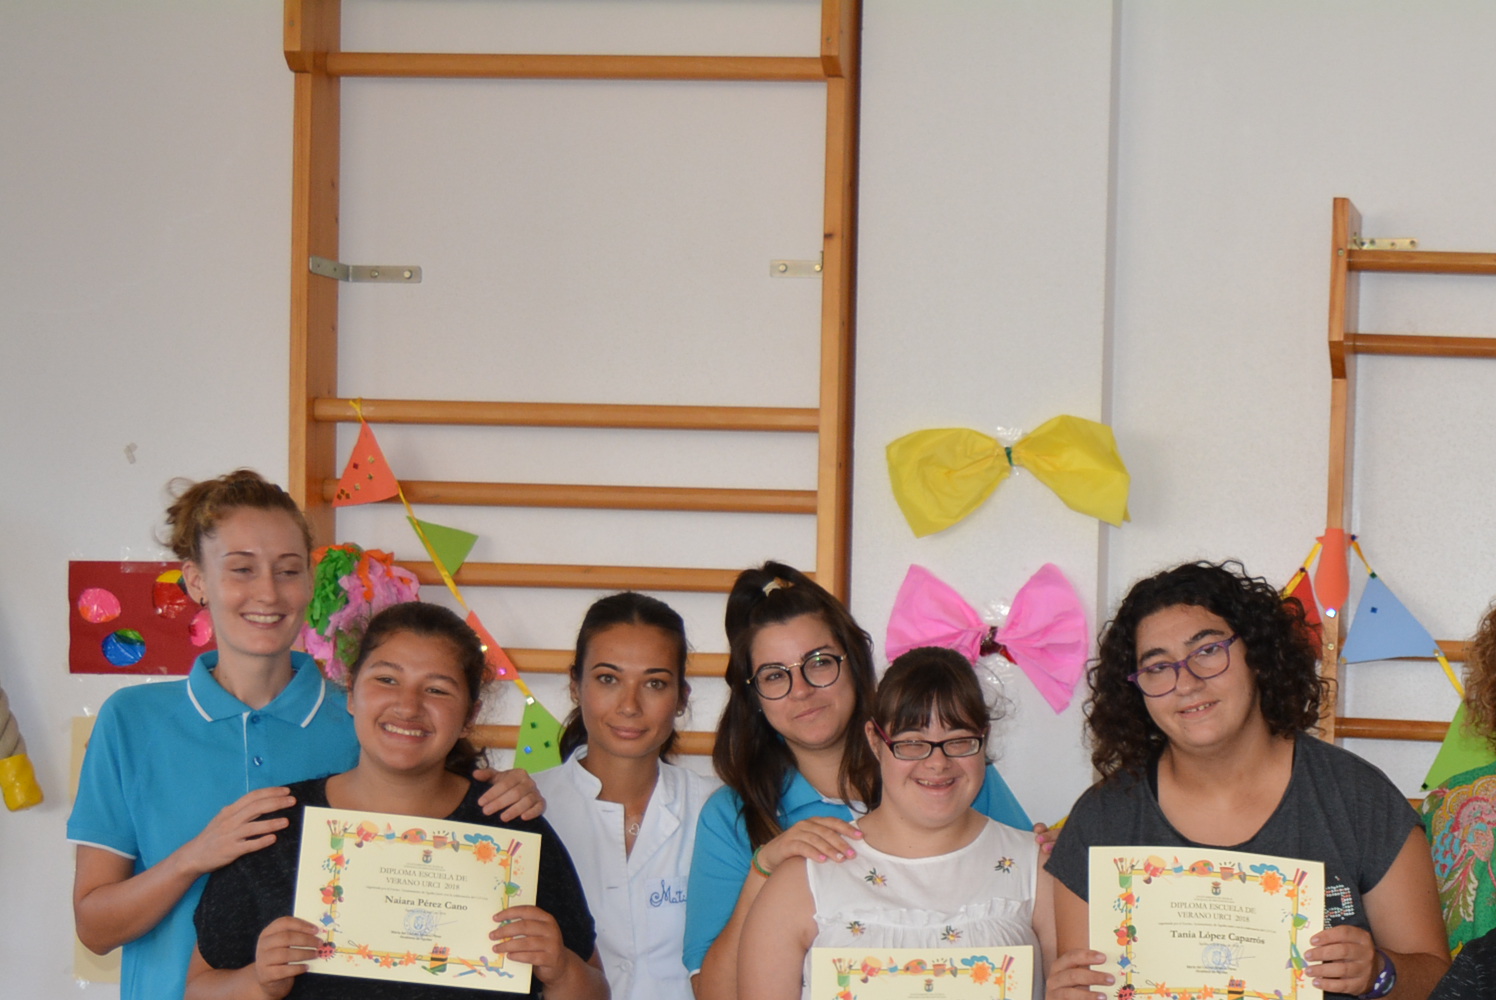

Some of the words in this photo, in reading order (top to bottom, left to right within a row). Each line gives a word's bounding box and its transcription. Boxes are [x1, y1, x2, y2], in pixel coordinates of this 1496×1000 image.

[380, 867, 417, 877] DIPLOMA
[419, 870, 454, 881] ESCUELA
[456, 874, 468, 882] DE
[386, 877, 421, 886] VERANO
[384, 895, 415, 906] Naiara
[417, 898, 442, 908] Pérez
[444, 901, 468, 911] Cano
[1170, 901, 1208, 910] DIPLOMA
[1209, 903, 1244, 912] ESCUELA
[1244, 906, 1256, 914] DE
[1177, 911, 1211, 919] VERANO
[1170, 930, 1196, 939] Tania
[1199, 930, 1226, 941] López
